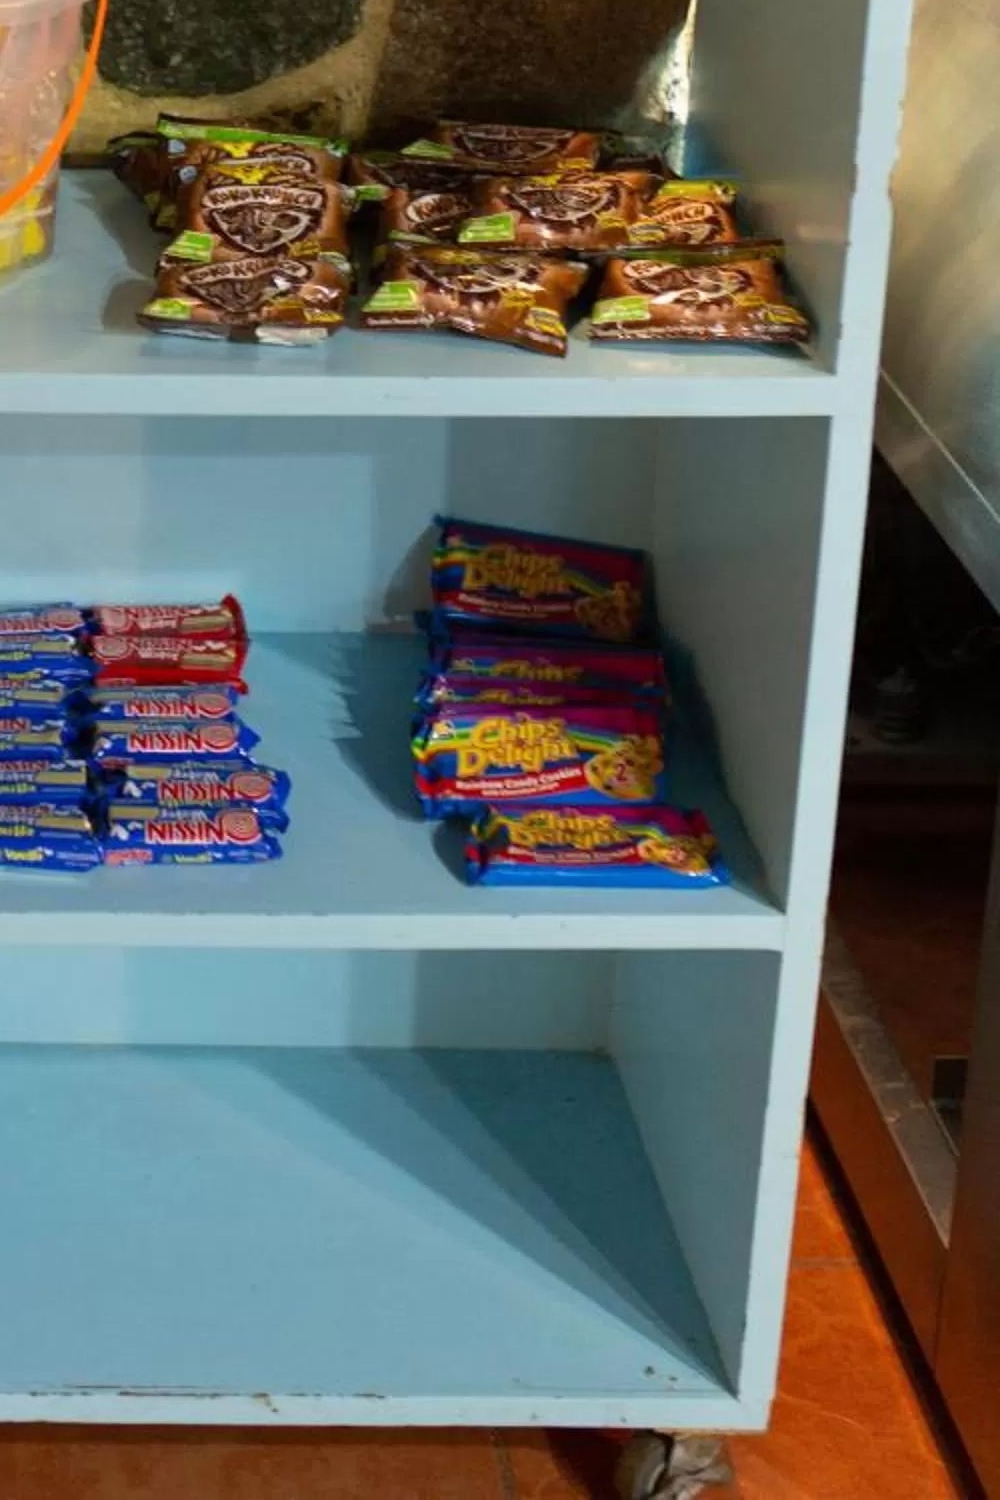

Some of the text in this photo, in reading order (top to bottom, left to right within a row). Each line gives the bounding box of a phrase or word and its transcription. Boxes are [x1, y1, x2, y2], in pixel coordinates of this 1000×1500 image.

[127, 700, 197, 716] NISSIN
[130, 731, 203, 750] NISSIN
[471, 715, 566, 748] Chips
[457, 740, 580, 777] Delight
[160, 780, 235, 801] NISSIN
[521, 810, 616, 831] Chips
[146, 821, 225, 842] NISSIN
